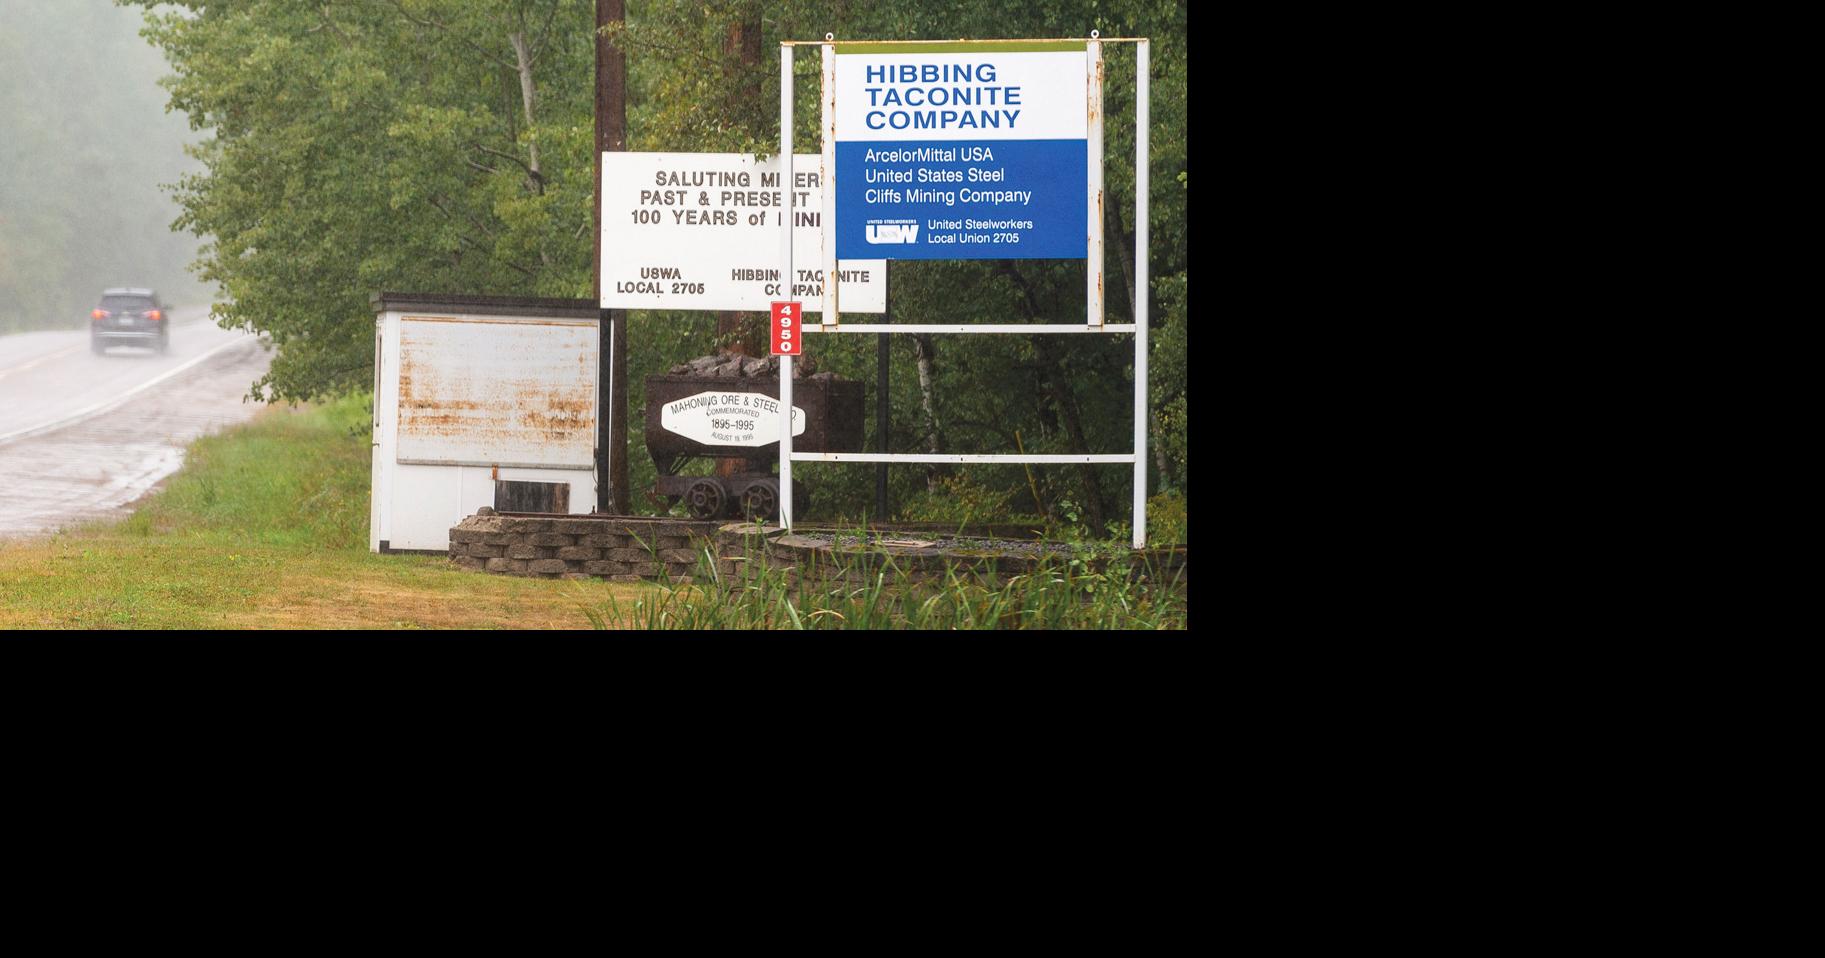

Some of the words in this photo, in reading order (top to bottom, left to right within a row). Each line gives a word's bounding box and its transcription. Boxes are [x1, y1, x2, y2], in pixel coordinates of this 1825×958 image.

[866, 64, 997, 83] HIBBING
[865, 87, 1021, 106] TACONITE
[865, 110, 1021, 129] COMPANY
[865, 148, 956, 163] ArcelorMittal
[961, 147, 994, 161] USA
[655, 170, 750, 187] SALUTING
[761, 172, 822, 188] MIER
[865, 168, 913, 183] United
[917, 168, 963, 182] States
[968, 168, 1004, 181] Steel
[640, 190, 687, 205] PAST
[698, 191, 710, 206] &
[865, 189, 901, 203] Cliffs
[906, 189, 955, 205] Mining
[959, 188, 1032, 205] Company
[631, 209, 661, 224] 100
[672, 209, 737, 225] YEARS
[748, 211, 766, 226] of
[928, 219, 962, 230] United
[965, 219, 1033, 230] Steelworkers
[928, 233, 956, 243] Local
[960, 233, 990, 243] Union
[993, 233, 1019, 243] 2705
[640, 267, 681, 279] USWA
[732, 269, 781, 281] HIBBIN
[797, 270, 870, 282] TACNITE
[617, 282, 664, 293] LOCAL
[672, 283, 705, 294] 2705
[780, 305, 792, 352] 4950
[670, 396, 718, 415] MAHONING
[721, 395, 740, 405] ORE
[743, 396, 749, 406] &
[753, 397, 780, 414] STEEL
[706, 407, 760, 418] COMMEMORATED
[711, 418, 755, 431] 1895-1995
